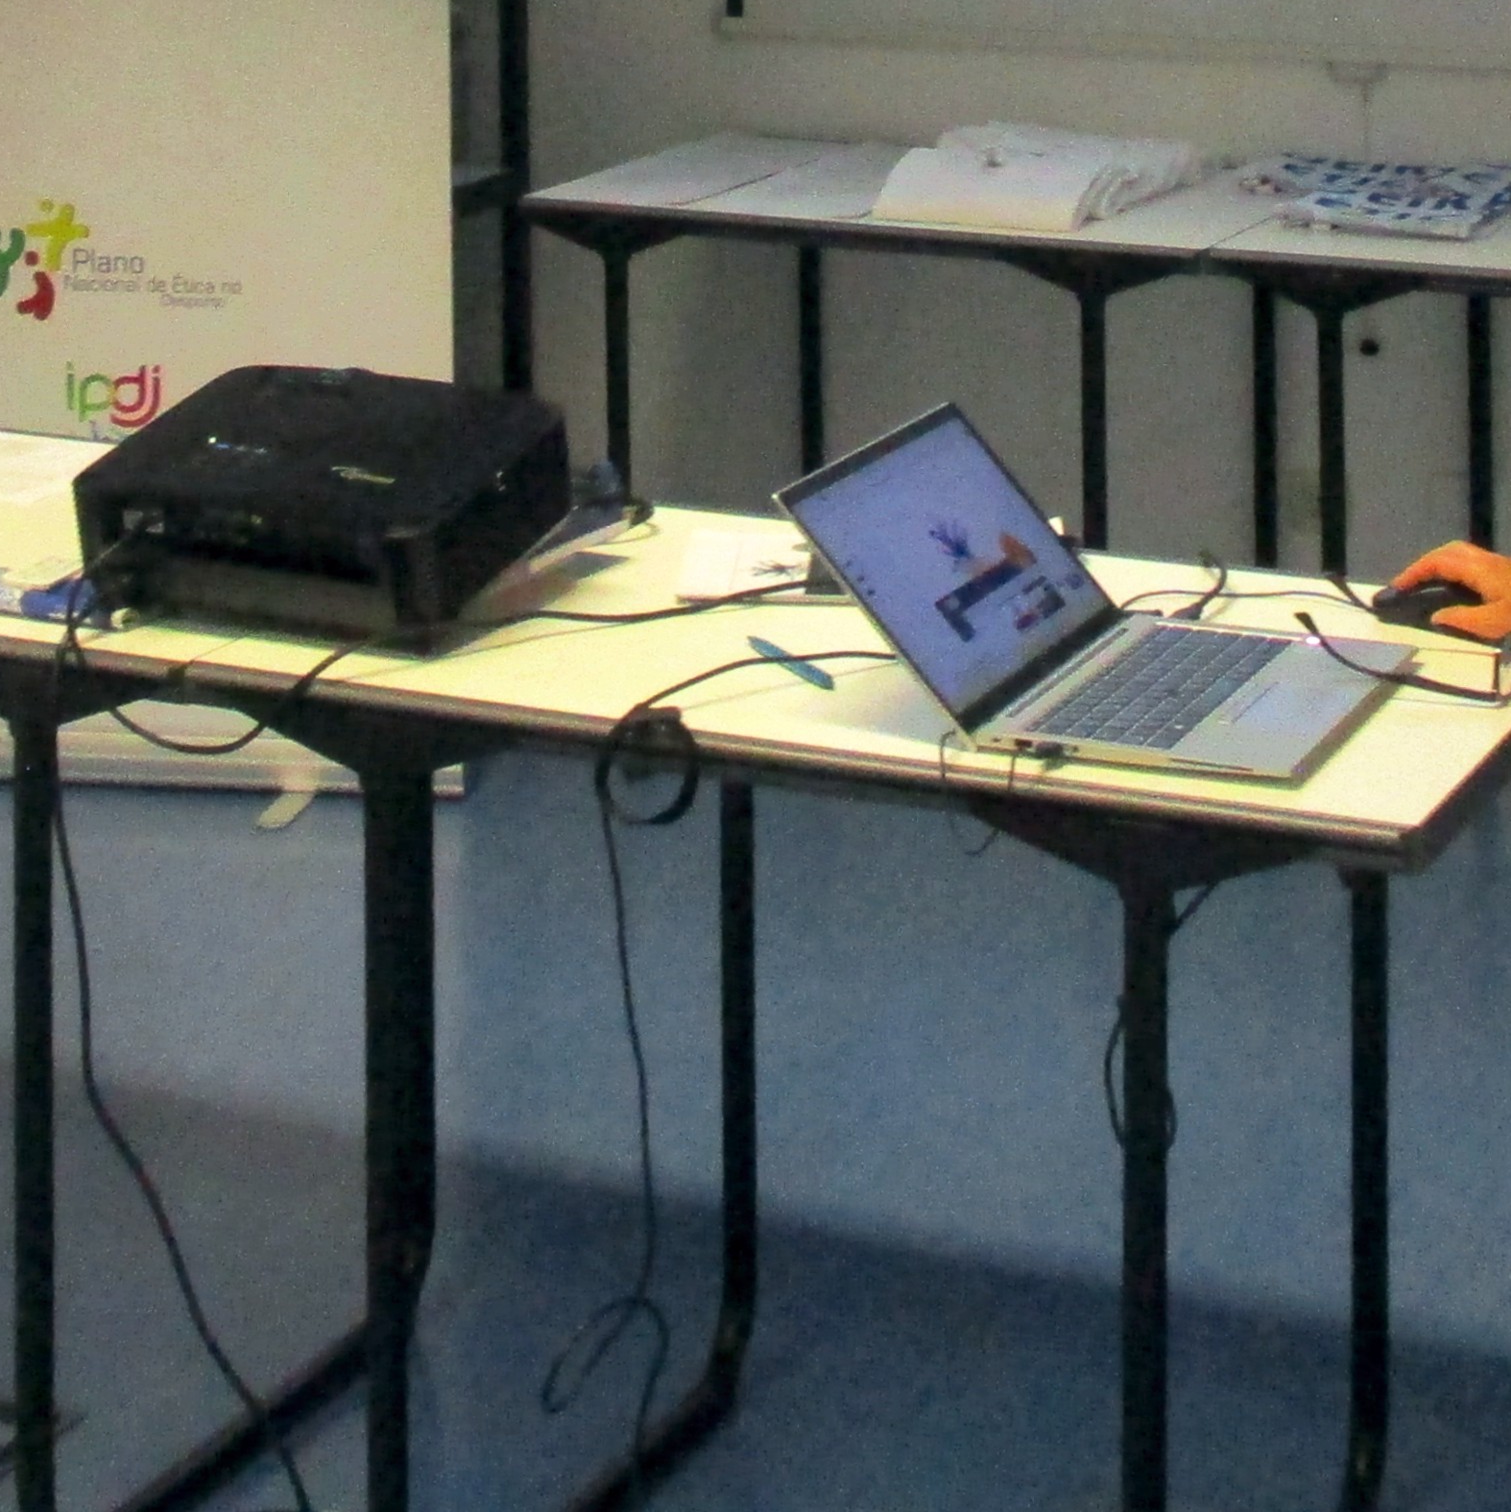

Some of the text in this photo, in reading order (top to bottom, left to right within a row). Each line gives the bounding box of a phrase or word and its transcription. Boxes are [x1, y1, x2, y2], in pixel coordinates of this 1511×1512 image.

[72, 248, 145, 274] Plano
[147, 276, 167, 293] de
[66, 361, 162, 429] ipdj
